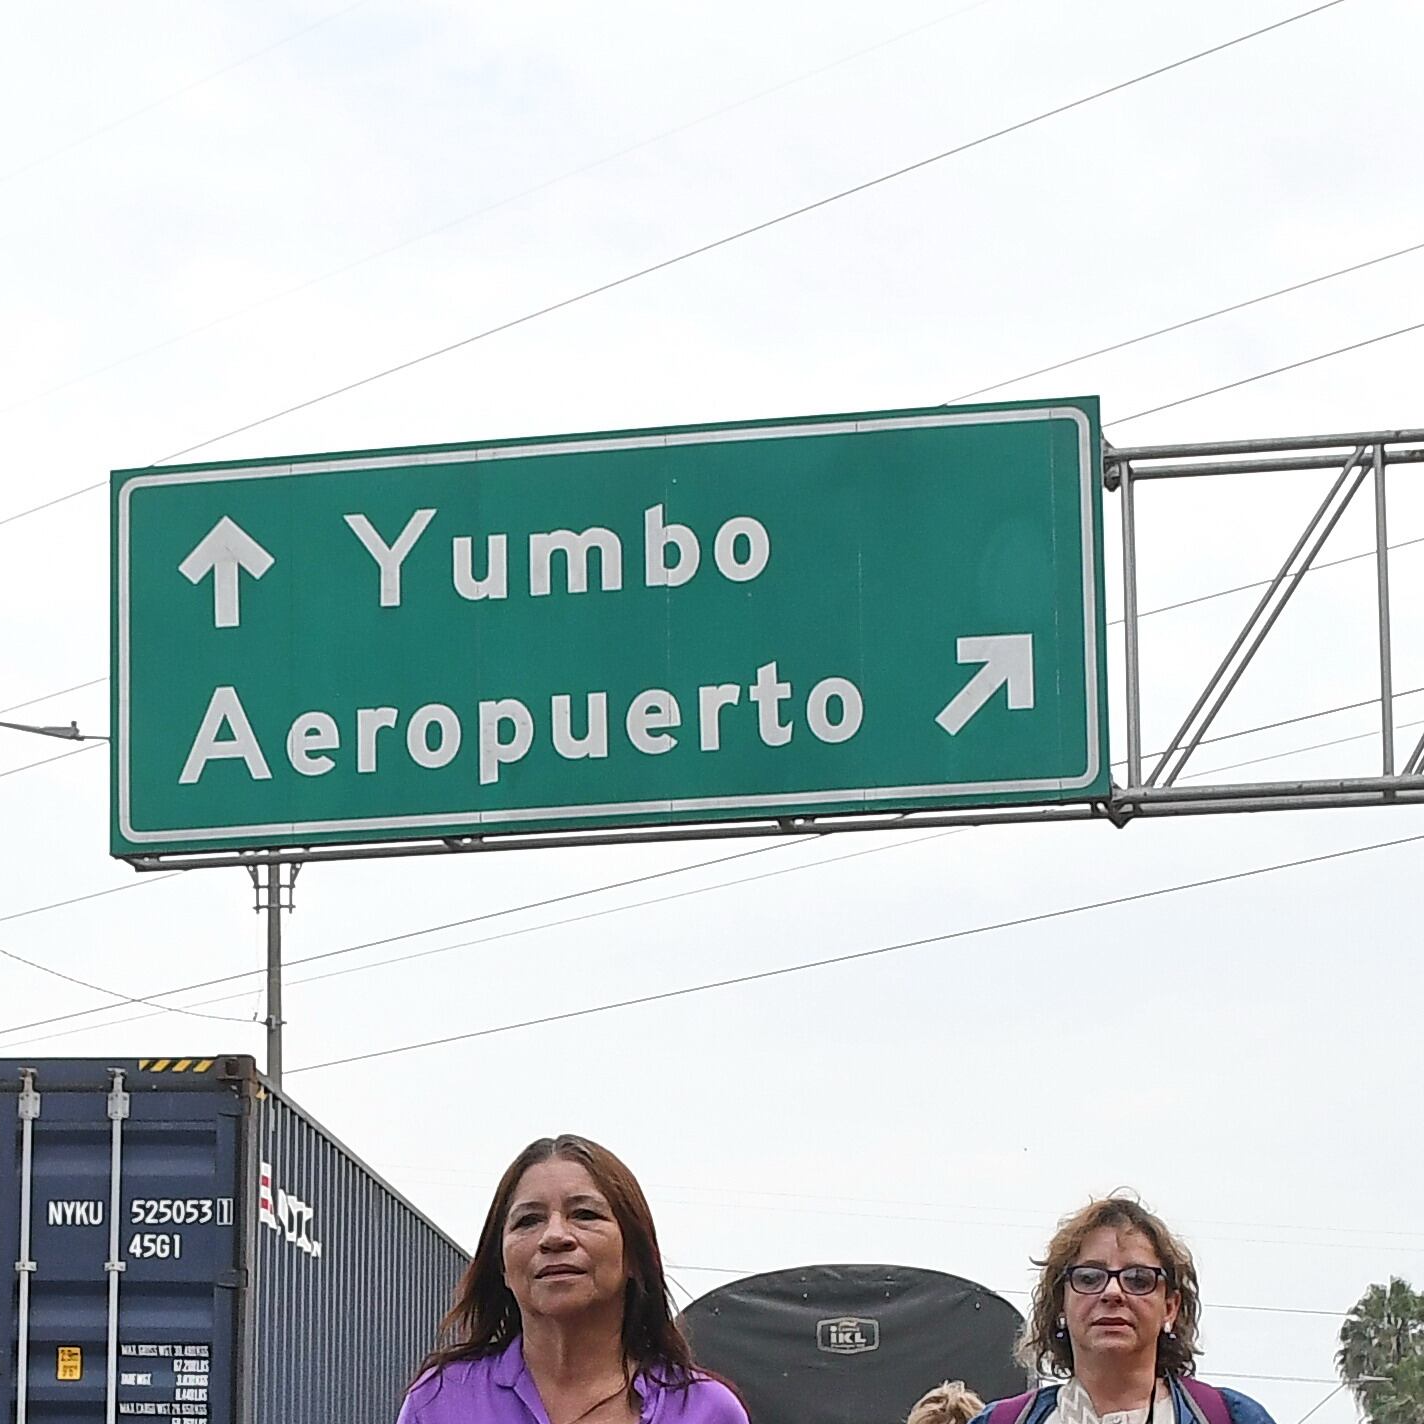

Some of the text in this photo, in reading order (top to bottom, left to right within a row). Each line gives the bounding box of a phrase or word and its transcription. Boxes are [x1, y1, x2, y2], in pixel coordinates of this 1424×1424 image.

[343, 503, 771, 608] Yumbo
[178, 661, 864, 785] Aeropuerto
[48, 1201, 103, 1215] NYKU
[131, 1200, 213, 1214] 525053
[129, 1234, 181, 1259] 45G1
